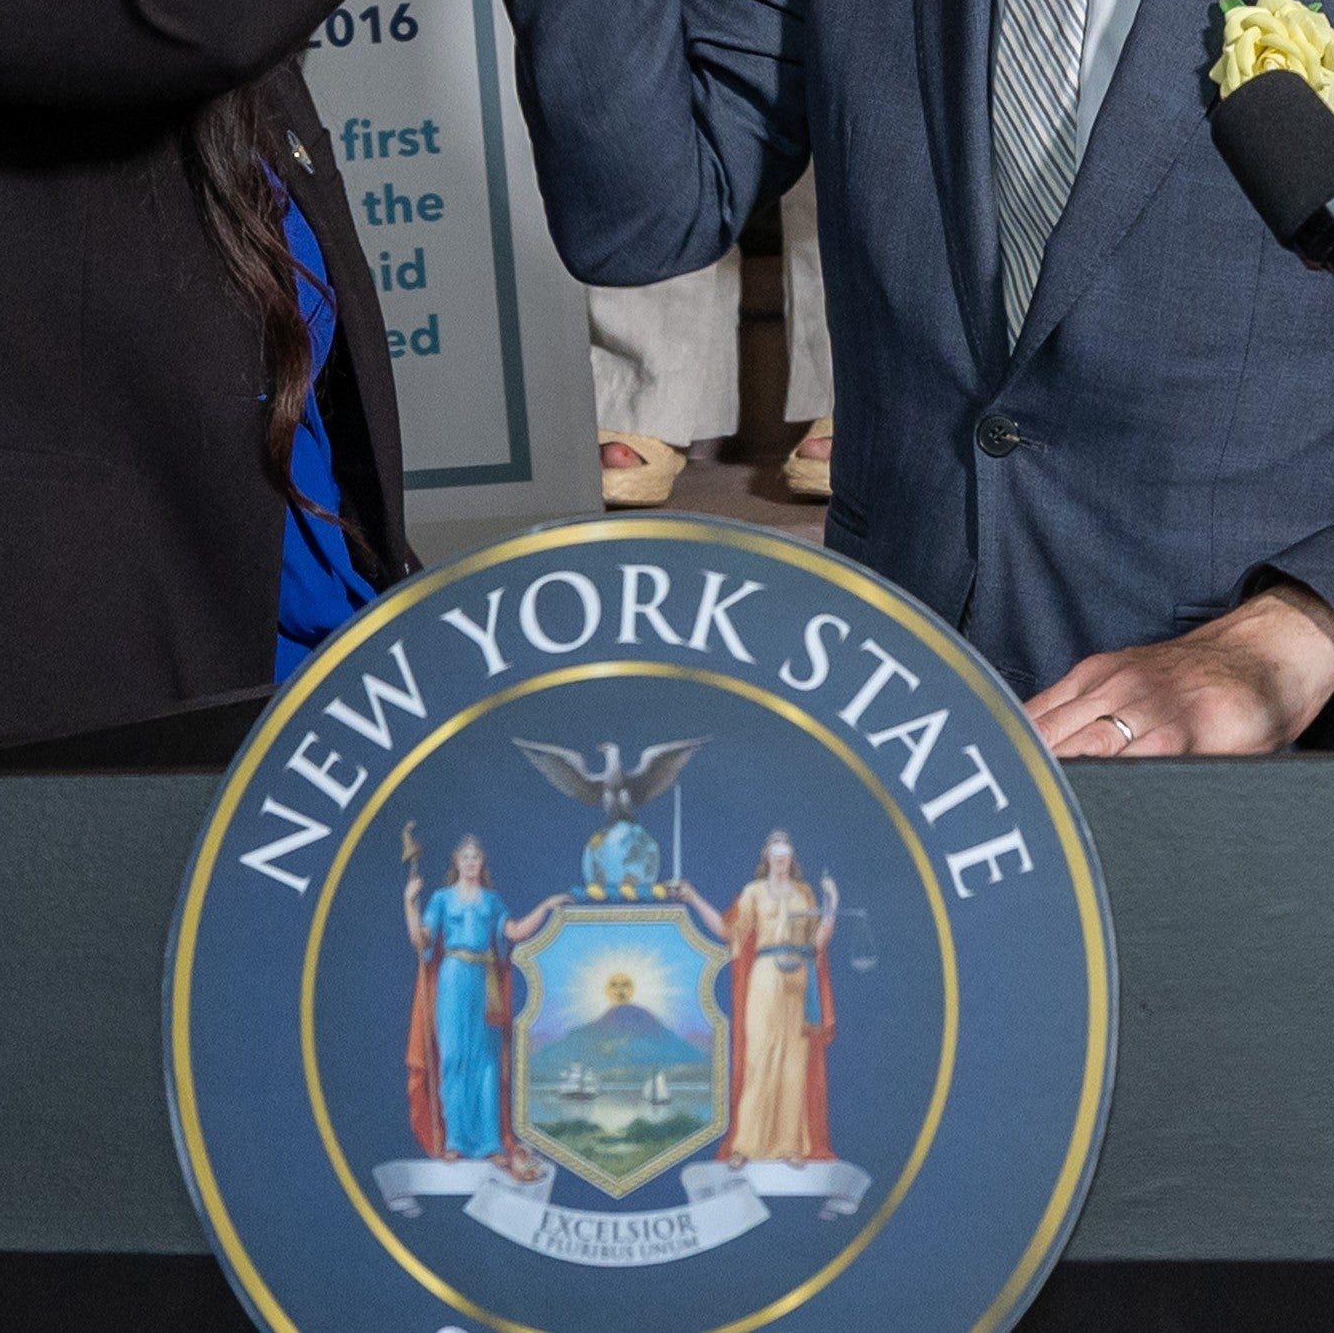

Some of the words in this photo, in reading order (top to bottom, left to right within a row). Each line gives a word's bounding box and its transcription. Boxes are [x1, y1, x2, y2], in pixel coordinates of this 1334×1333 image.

[339, 117, 441, 162] first
[361, 182, 445, 227] the
[371, 246, 428, 293] id
[238, 640, 431, 896] NEW
[439, 563, 768, 679] YORK
[778, 613, 1034, 900] STATE
[539, 1209, 698, 1245] EXCELSIOR
